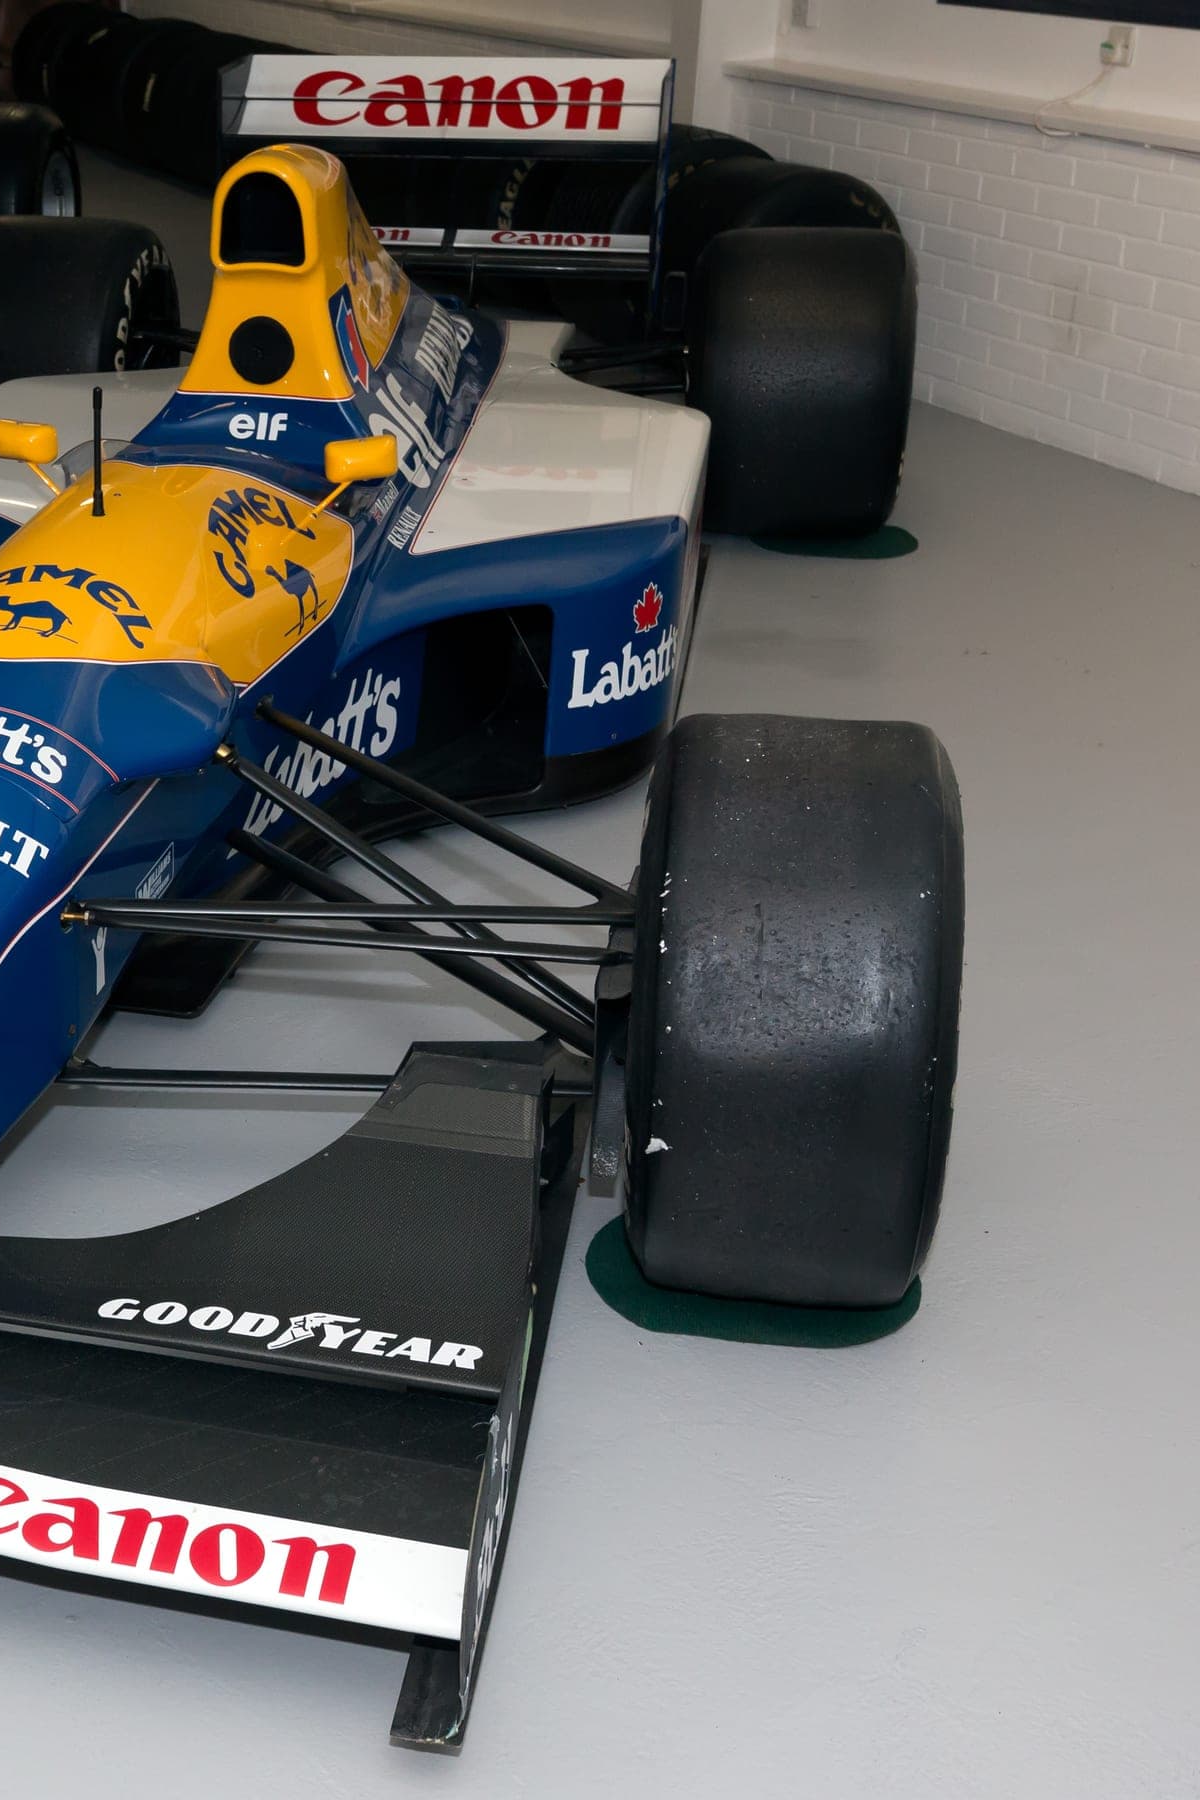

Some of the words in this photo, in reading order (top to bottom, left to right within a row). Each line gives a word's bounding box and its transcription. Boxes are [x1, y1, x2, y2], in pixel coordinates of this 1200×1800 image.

[292, 70, 625, 130] Canon
[490, 230, 612, 248] Canon
[228, 413, 289, 441] elf
[368, 372, 446, 489] elf
[207, 487, 317, 598] CAMEL
